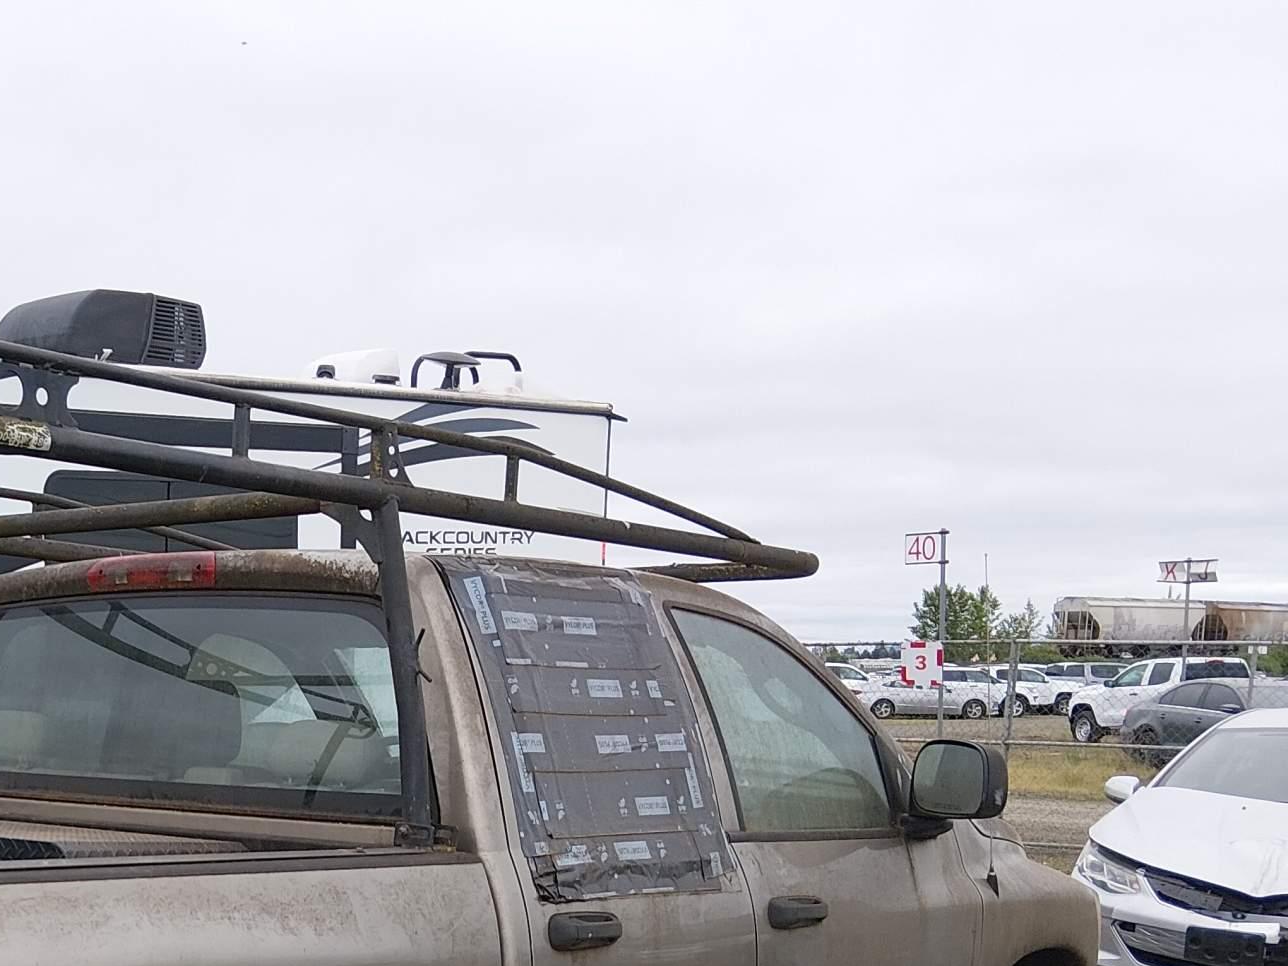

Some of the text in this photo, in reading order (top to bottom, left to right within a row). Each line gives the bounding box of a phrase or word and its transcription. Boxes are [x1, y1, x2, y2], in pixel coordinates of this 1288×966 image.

[402, 531, 535, 544] ACKCOUNTRY
[908, 535, 936, 560] 40
[1164, 563, 1177, 580] K
[1198, 562, 1210, 580] J
[915, 655, 927, 670] 3
